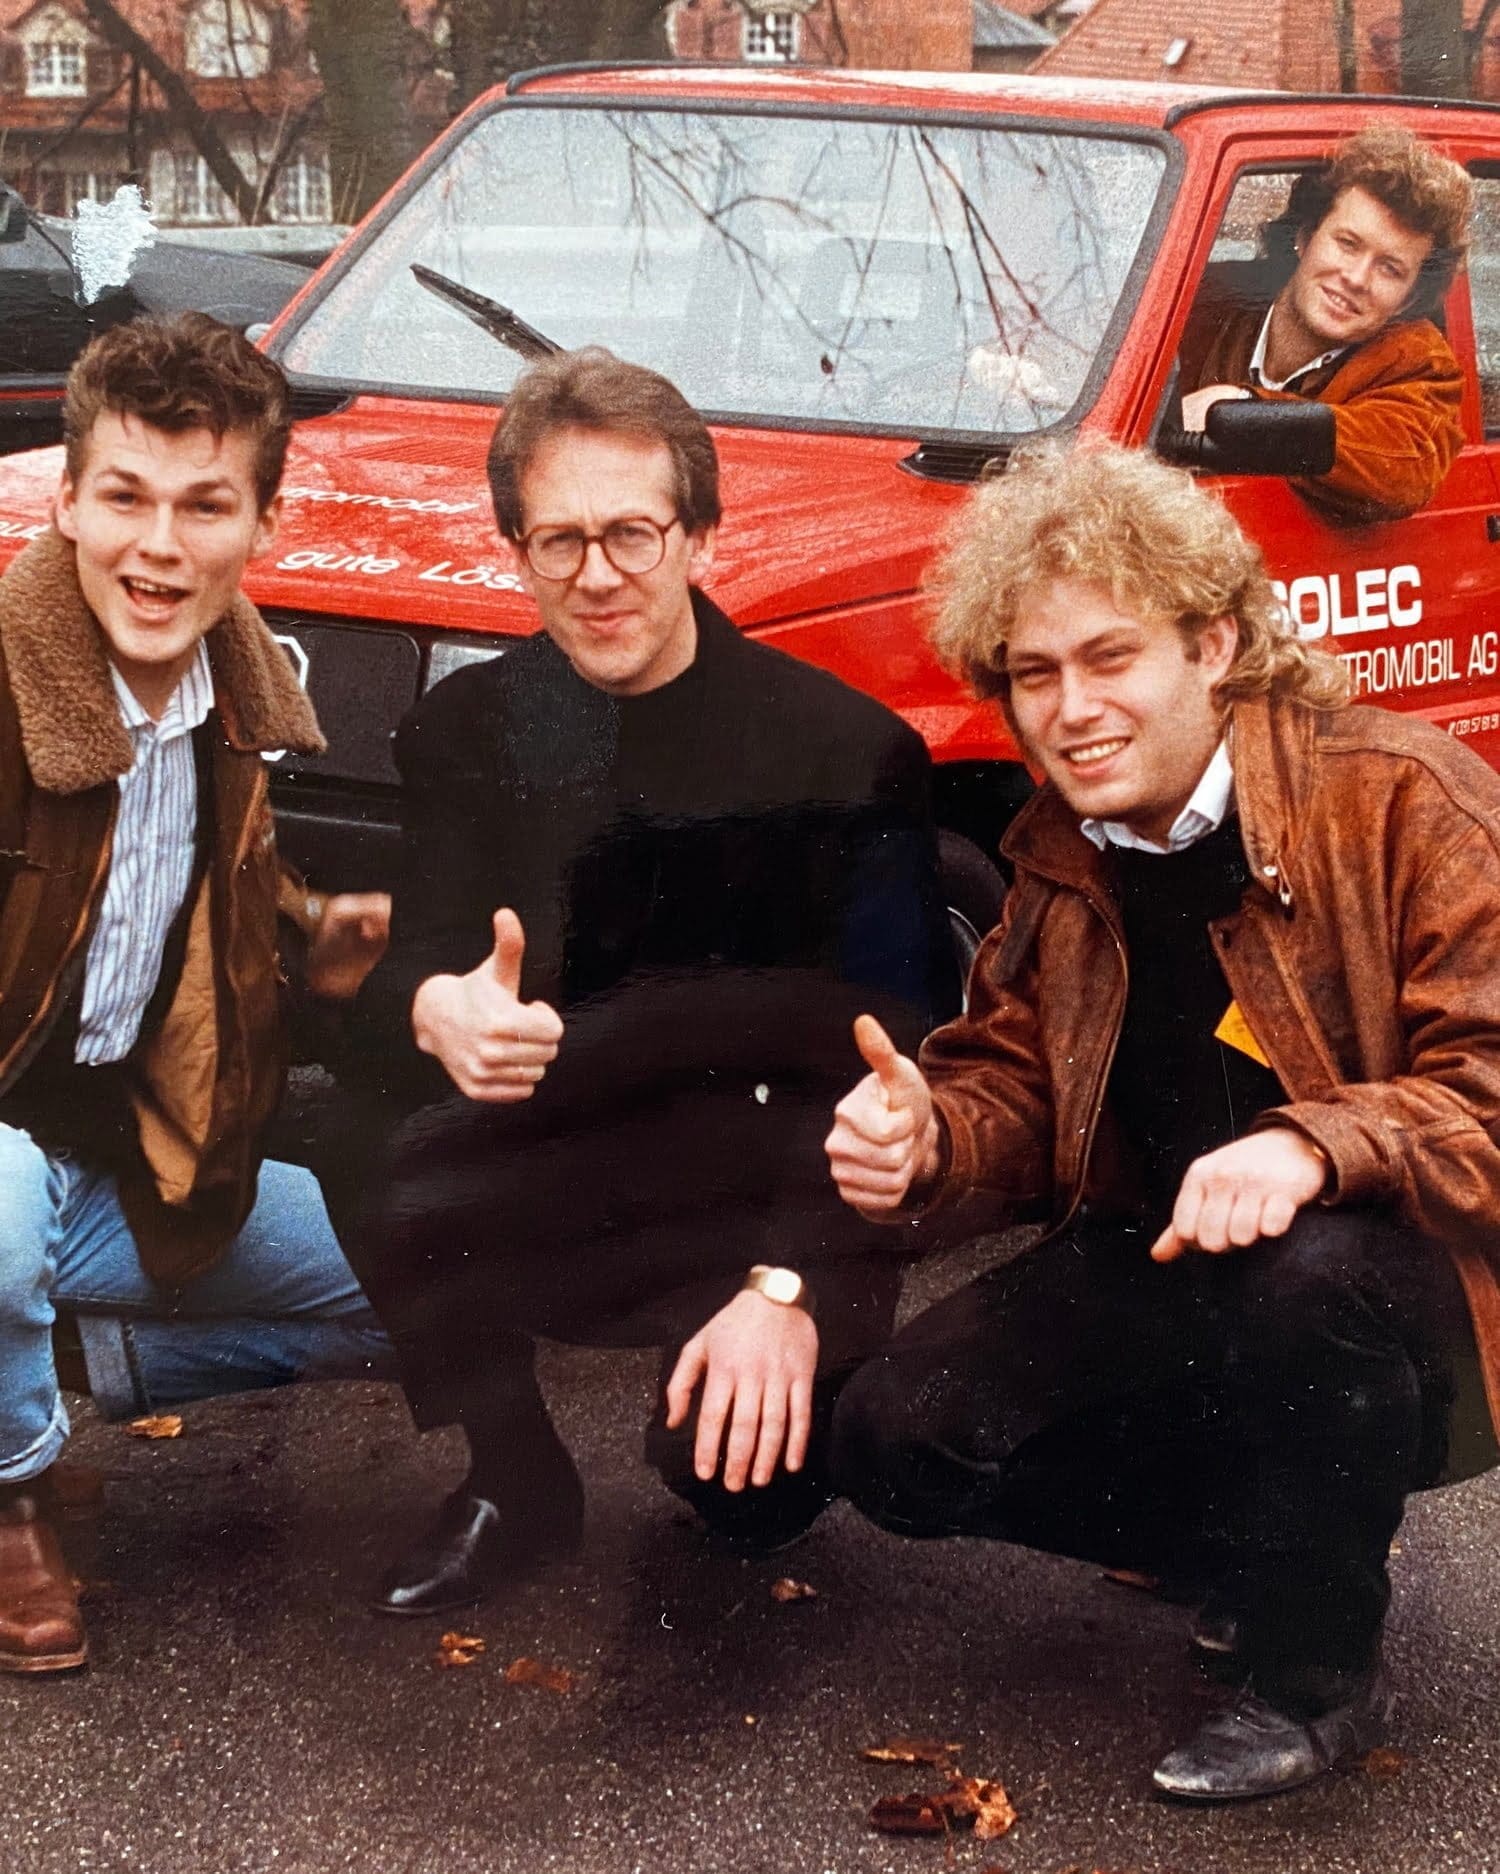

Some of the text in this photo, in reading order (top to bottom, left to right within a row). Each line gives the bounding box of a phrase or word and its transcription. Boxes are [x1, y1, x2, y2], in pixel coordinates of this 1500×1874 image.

[276, 551, 524, 592] gute Lös
[1467, 631, 1498, 677] AG
